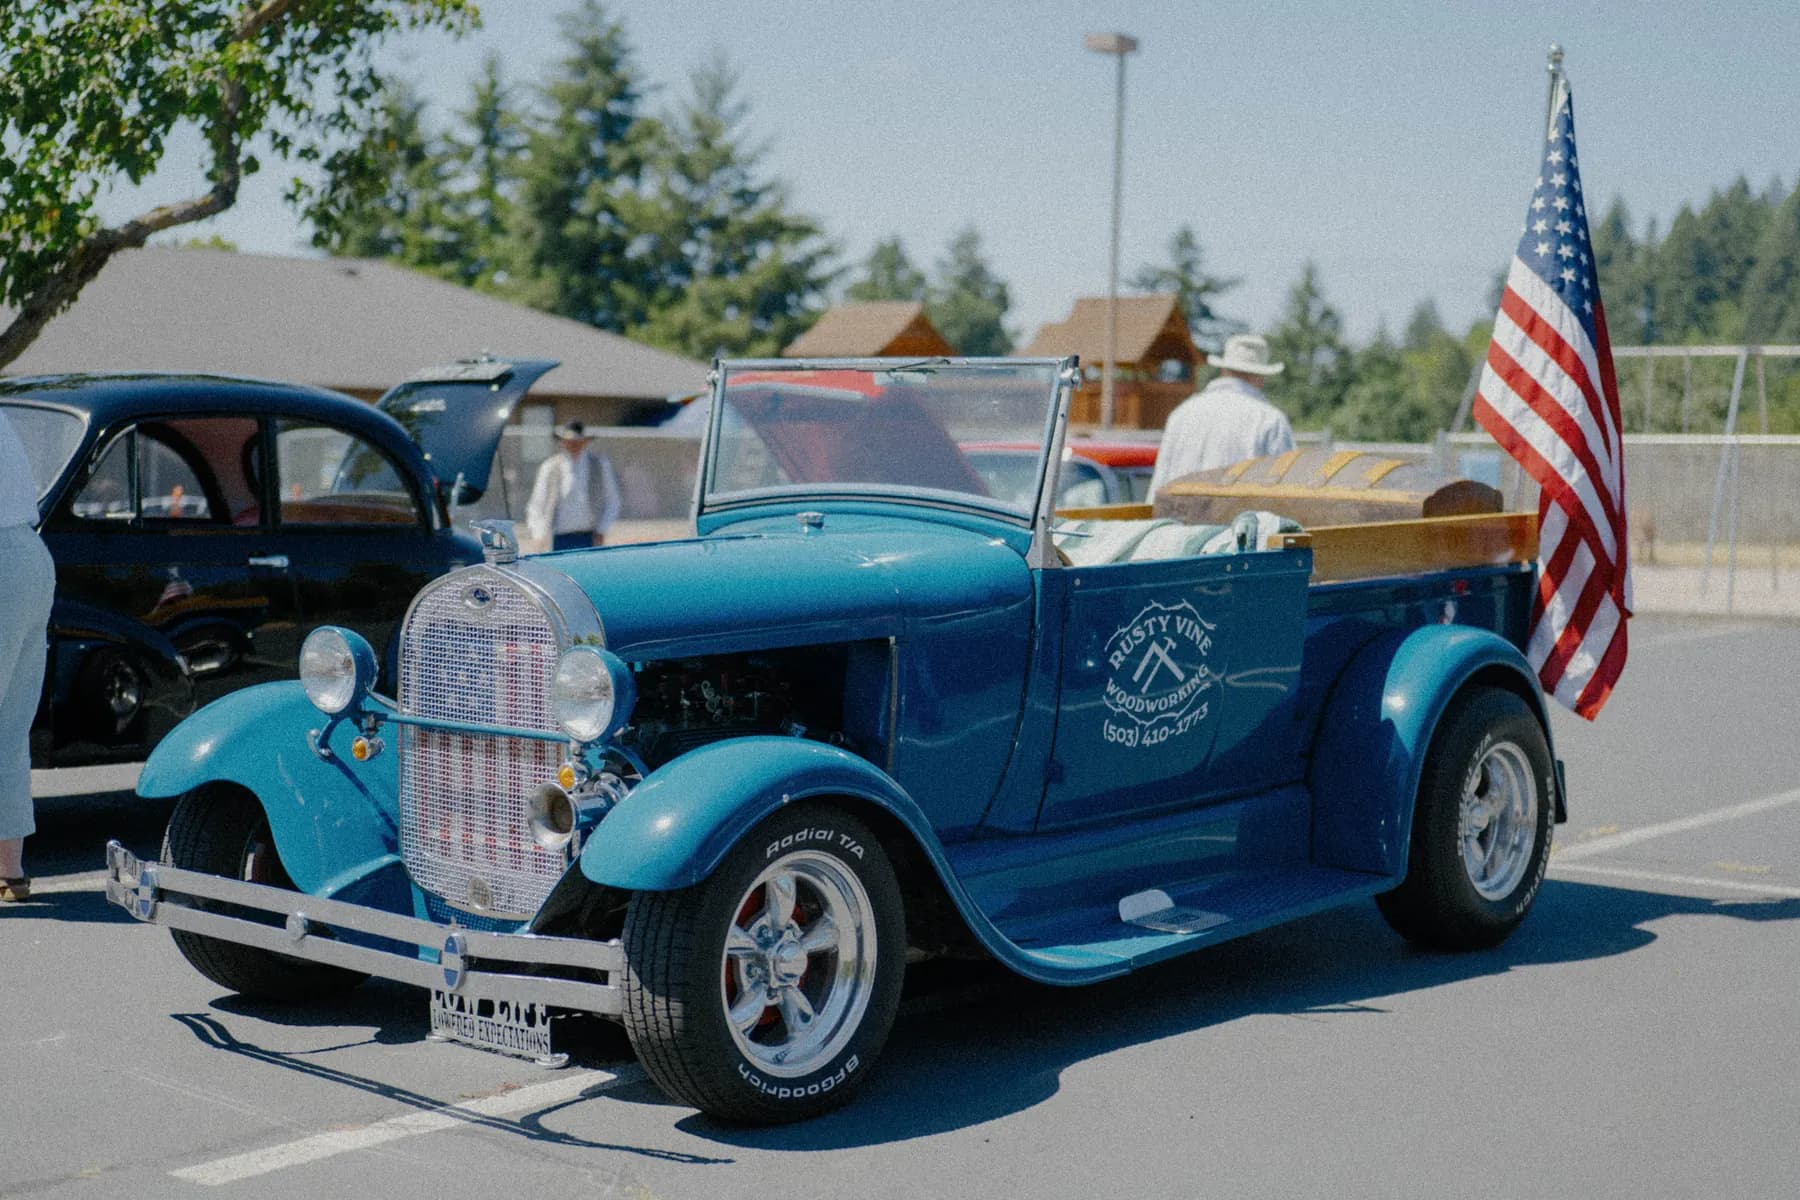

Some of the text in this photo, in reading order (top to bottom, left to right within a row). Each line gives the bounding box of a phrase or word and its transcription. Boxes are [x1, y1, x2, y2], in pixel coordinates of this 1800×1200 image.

[1108, 615, 1212, 671] RUSTY VINE
[1105, 663, 1209, 713] WOODWORKING
[1103, 701, 1209, 748] (503) 410-1773
[766, 827, 865, 860] Radial T/A
[478, 1019, 550, 1056] EXPECTATIONS
[737, 1053, 860, 1099] BFGoodrich
